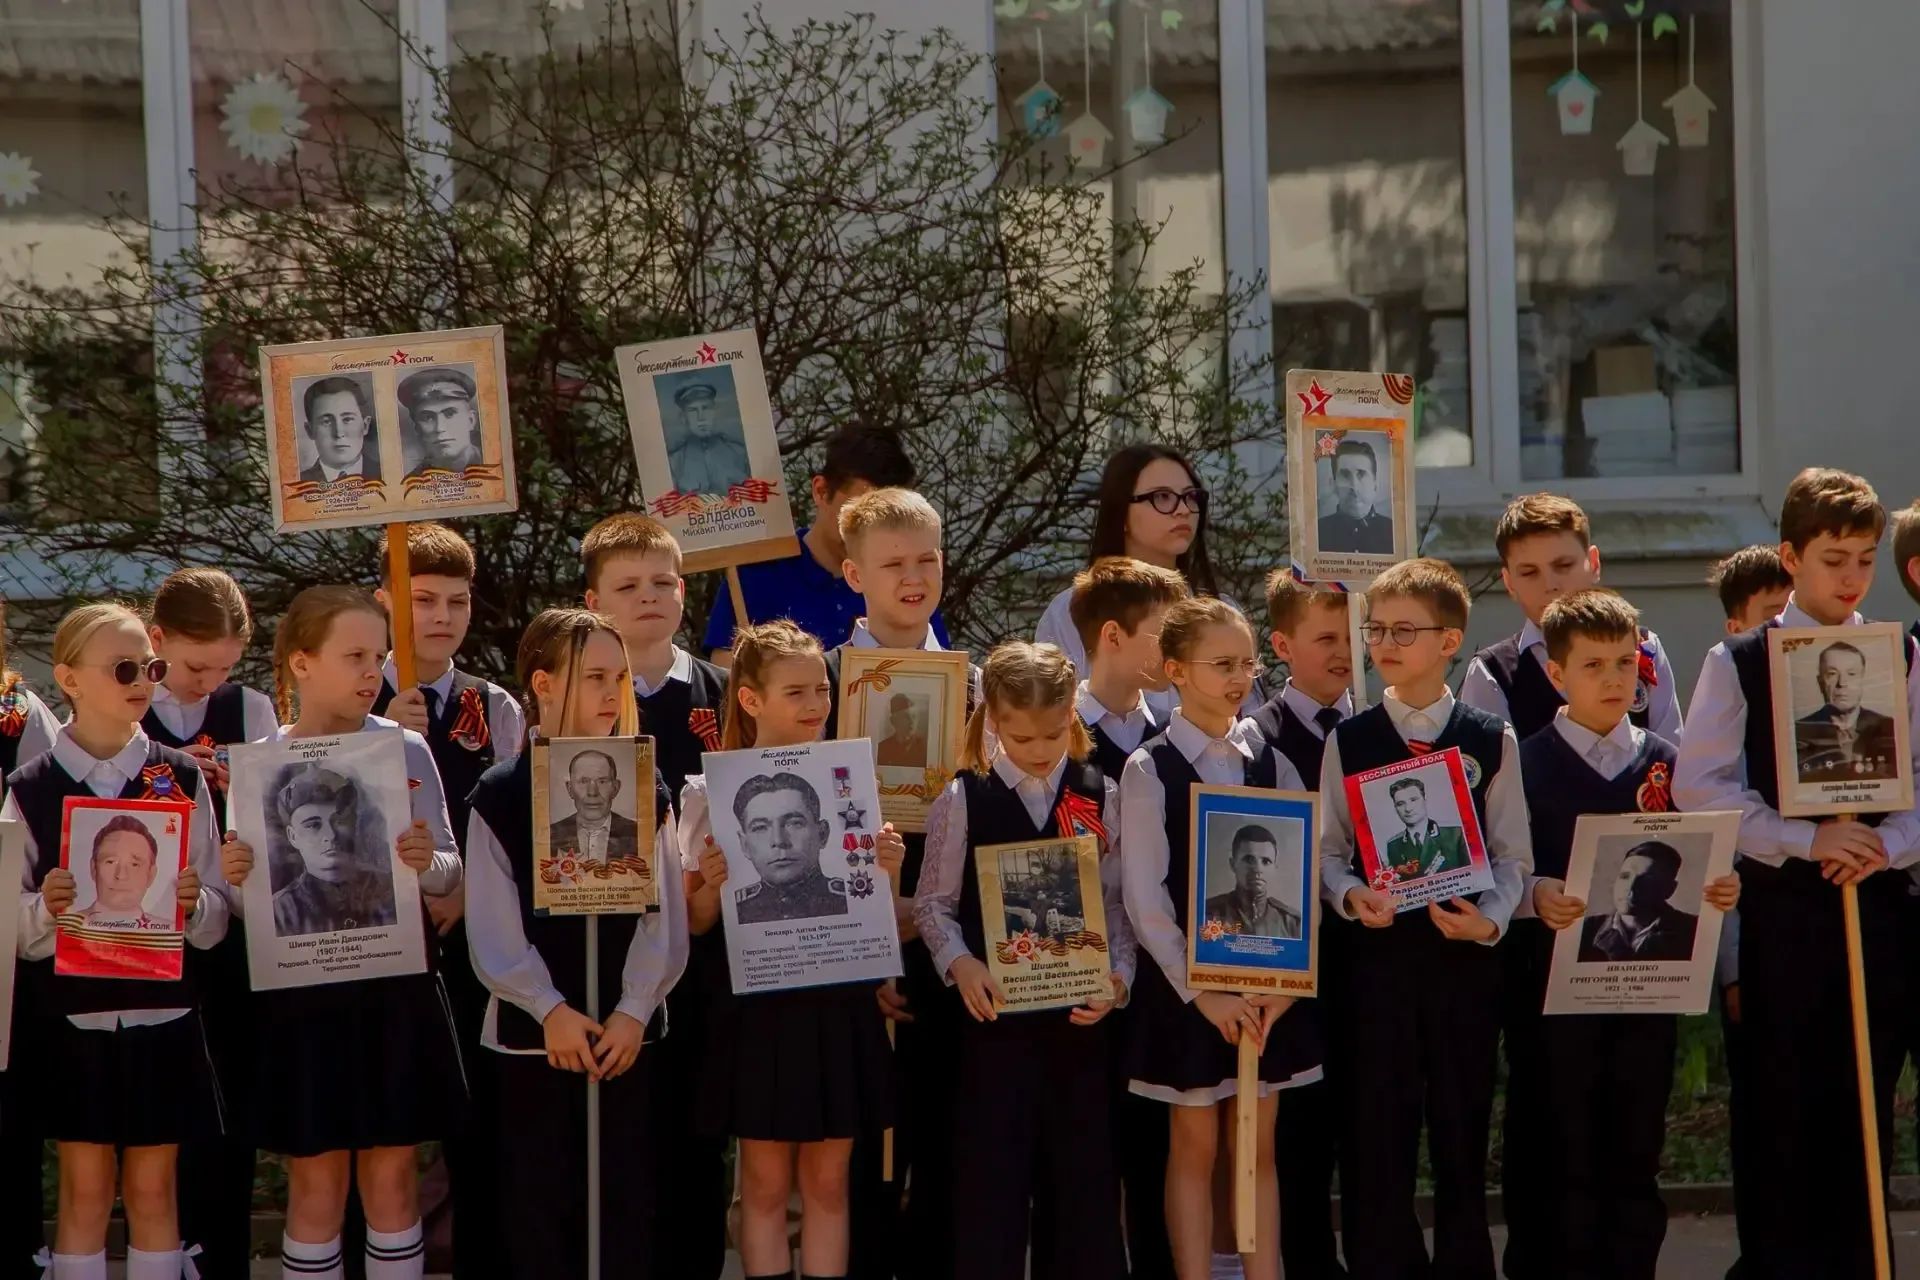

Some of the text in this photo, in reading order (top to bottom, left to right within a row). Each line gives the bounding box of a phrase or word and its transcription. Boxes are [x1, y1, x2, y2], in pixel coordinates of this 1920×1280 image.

[318, 480, 364, 491] Сидоров
[688, 506, 756, 526] Балдаков
[682, 526, 717, 537] Михаил
[1358, 752, 1446, 782] БЕССМЕРТНЫЙ ПОЛК
[1389, 871, 1472, 897] Уваров Василий
[318, 937, 340, 946] Иван
[341, 932, 389, 945] Давидович
[316, 945, 363, 957] (1907-1944)
[312, 956, 335, 965] Погиб
[1002, 974, 1042, 985] Василий
[1190, 972, 1314, 991] БЕССМЕРТНЫЙ ПОЛК
[1005, 989, 1103, 1006] вардии младший сержант
